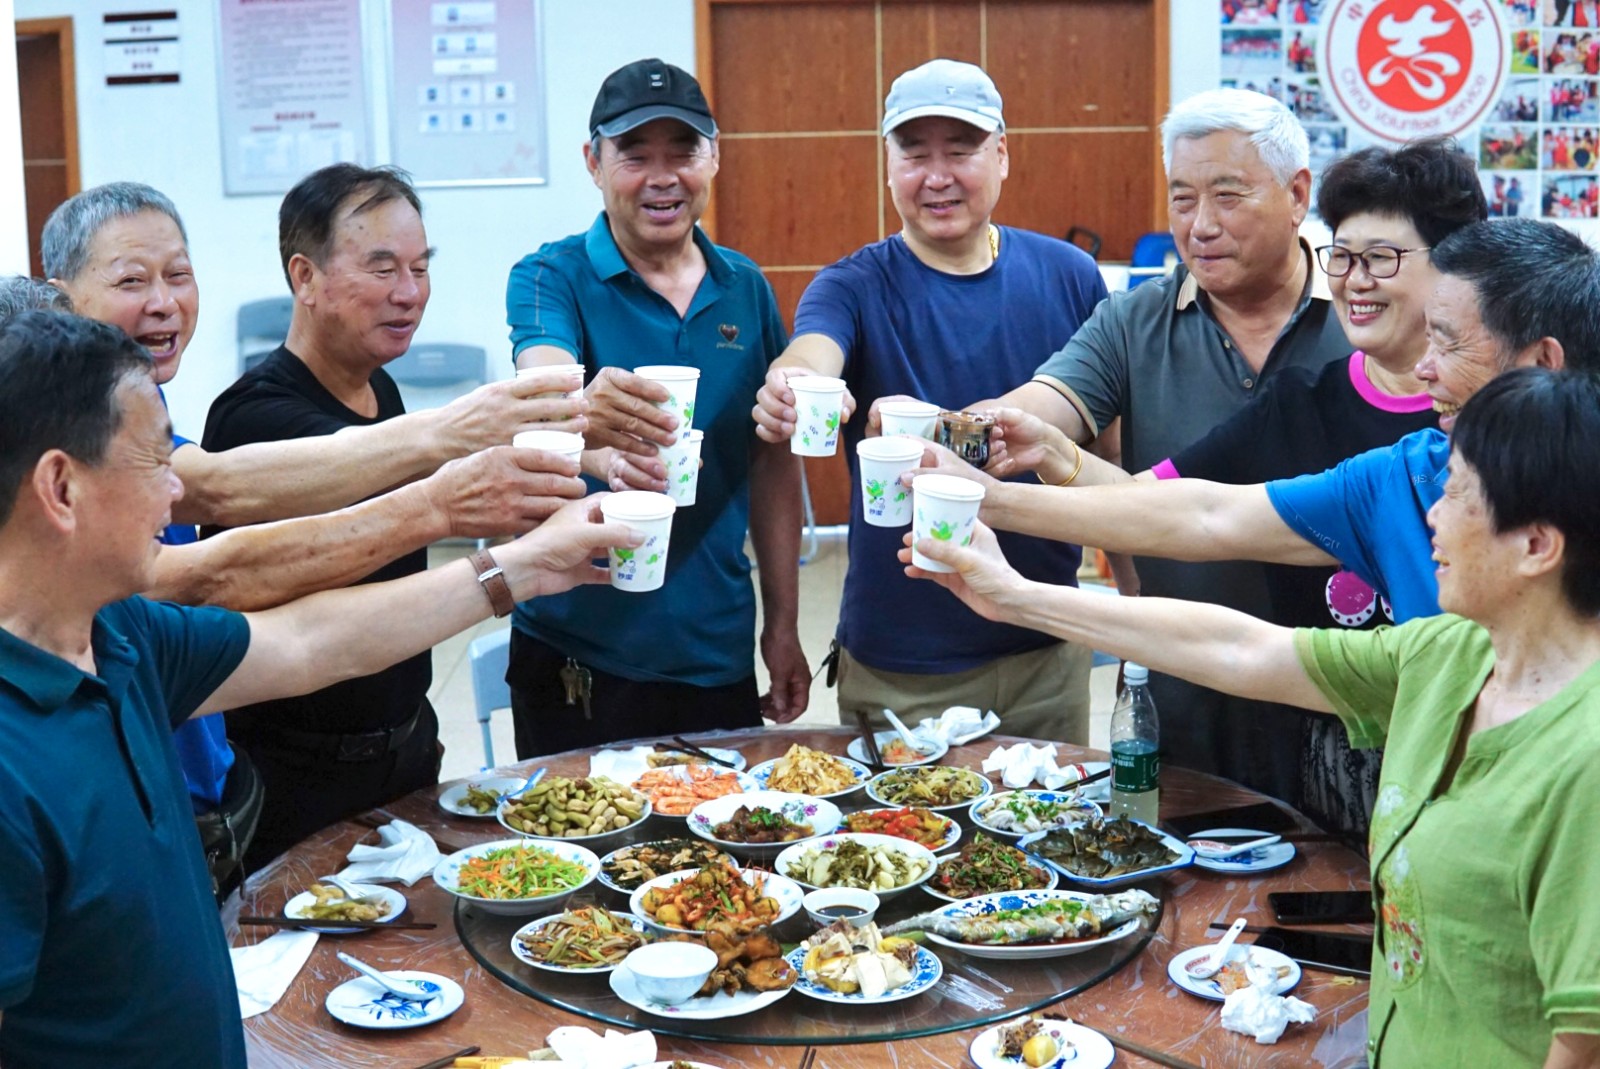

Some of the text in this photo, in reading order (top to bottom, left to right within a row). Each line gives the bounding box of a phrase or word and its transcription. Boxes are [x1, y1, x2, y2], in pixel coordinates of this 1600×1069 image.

[1342, 68, 1487, 130] China Volunteer Service
